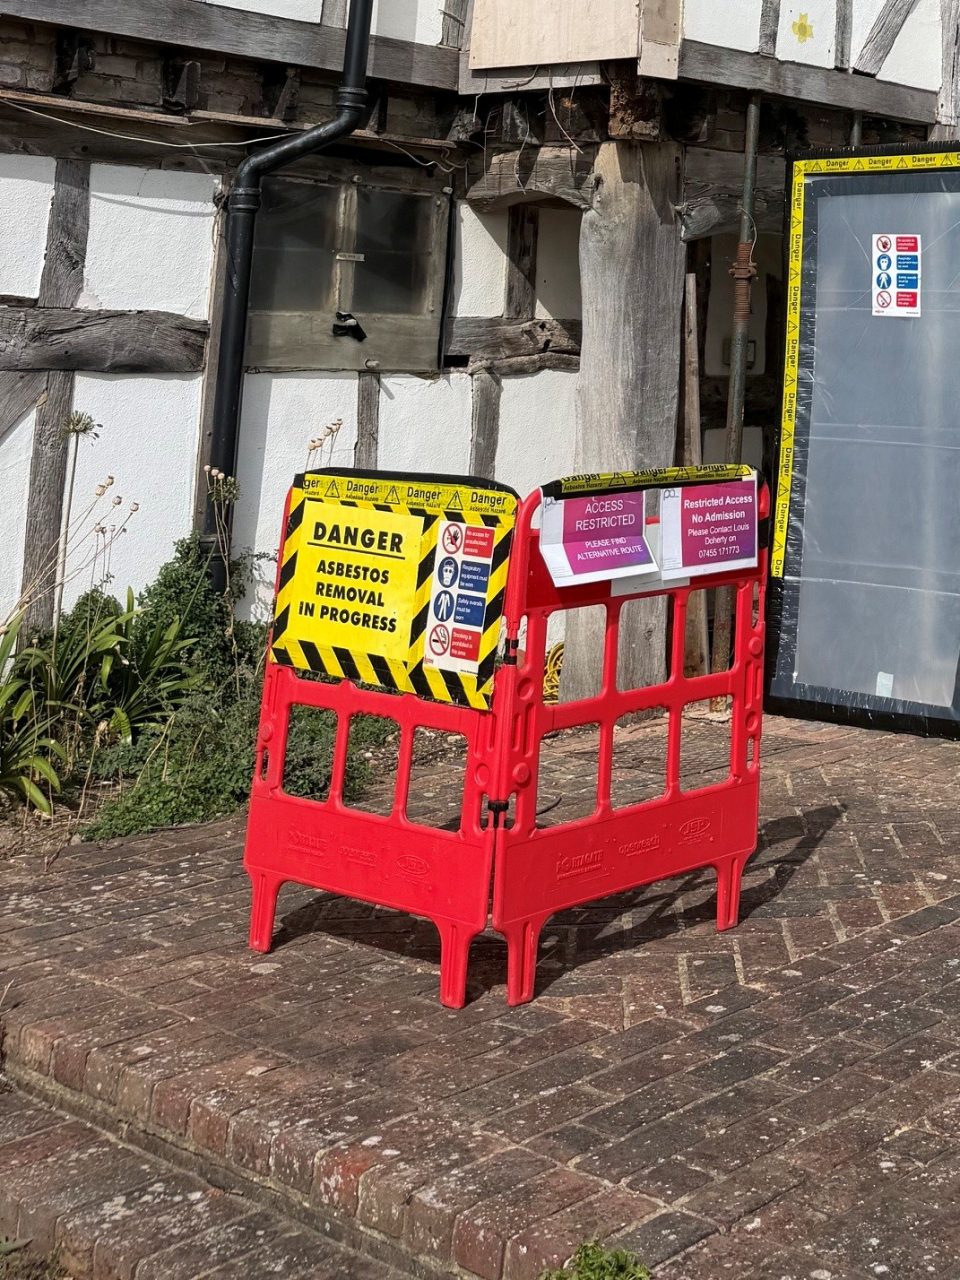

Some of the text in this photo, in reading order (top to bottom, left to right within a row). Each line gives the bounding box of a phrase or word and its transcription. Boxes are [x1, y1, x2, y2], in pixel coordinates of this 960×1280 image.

[826, 160, 849, 169] Danger
[868, 158, 892, 166] Danger
[912, 156, 936, 164] Danger
[795, 183, 803, 210] Danger
[346, 480, 379, 495] Danger
[407, 486, 441, 501] Danger
[471, 492, 508, 507] Danger
[585, 500, 624, 514] ACCESS
[684, 495, 752, 509] Restricted Access
[575, 514, 635, 531] RESTRICTED
[692, 510, 745, 524] No Admission
[780, 503, 788, 533] Danger
[688, 523, 749, 536] Please Contact Louis
[313, 522, 403, 553] DANGER
[585, 537, 626, 548] PLEASE FIND
[705, 536, 728, 545] Doherty
[577, 545, 643, 560] ALTERNATIVE ROUTE
[698, 546, 740, 558] 07455 171773
[317, 560, 389, 584] ASBESTOS
[316, 582, 385, 607] REMOVAL
[299, 601, 397, 633] IN PROGRESS
